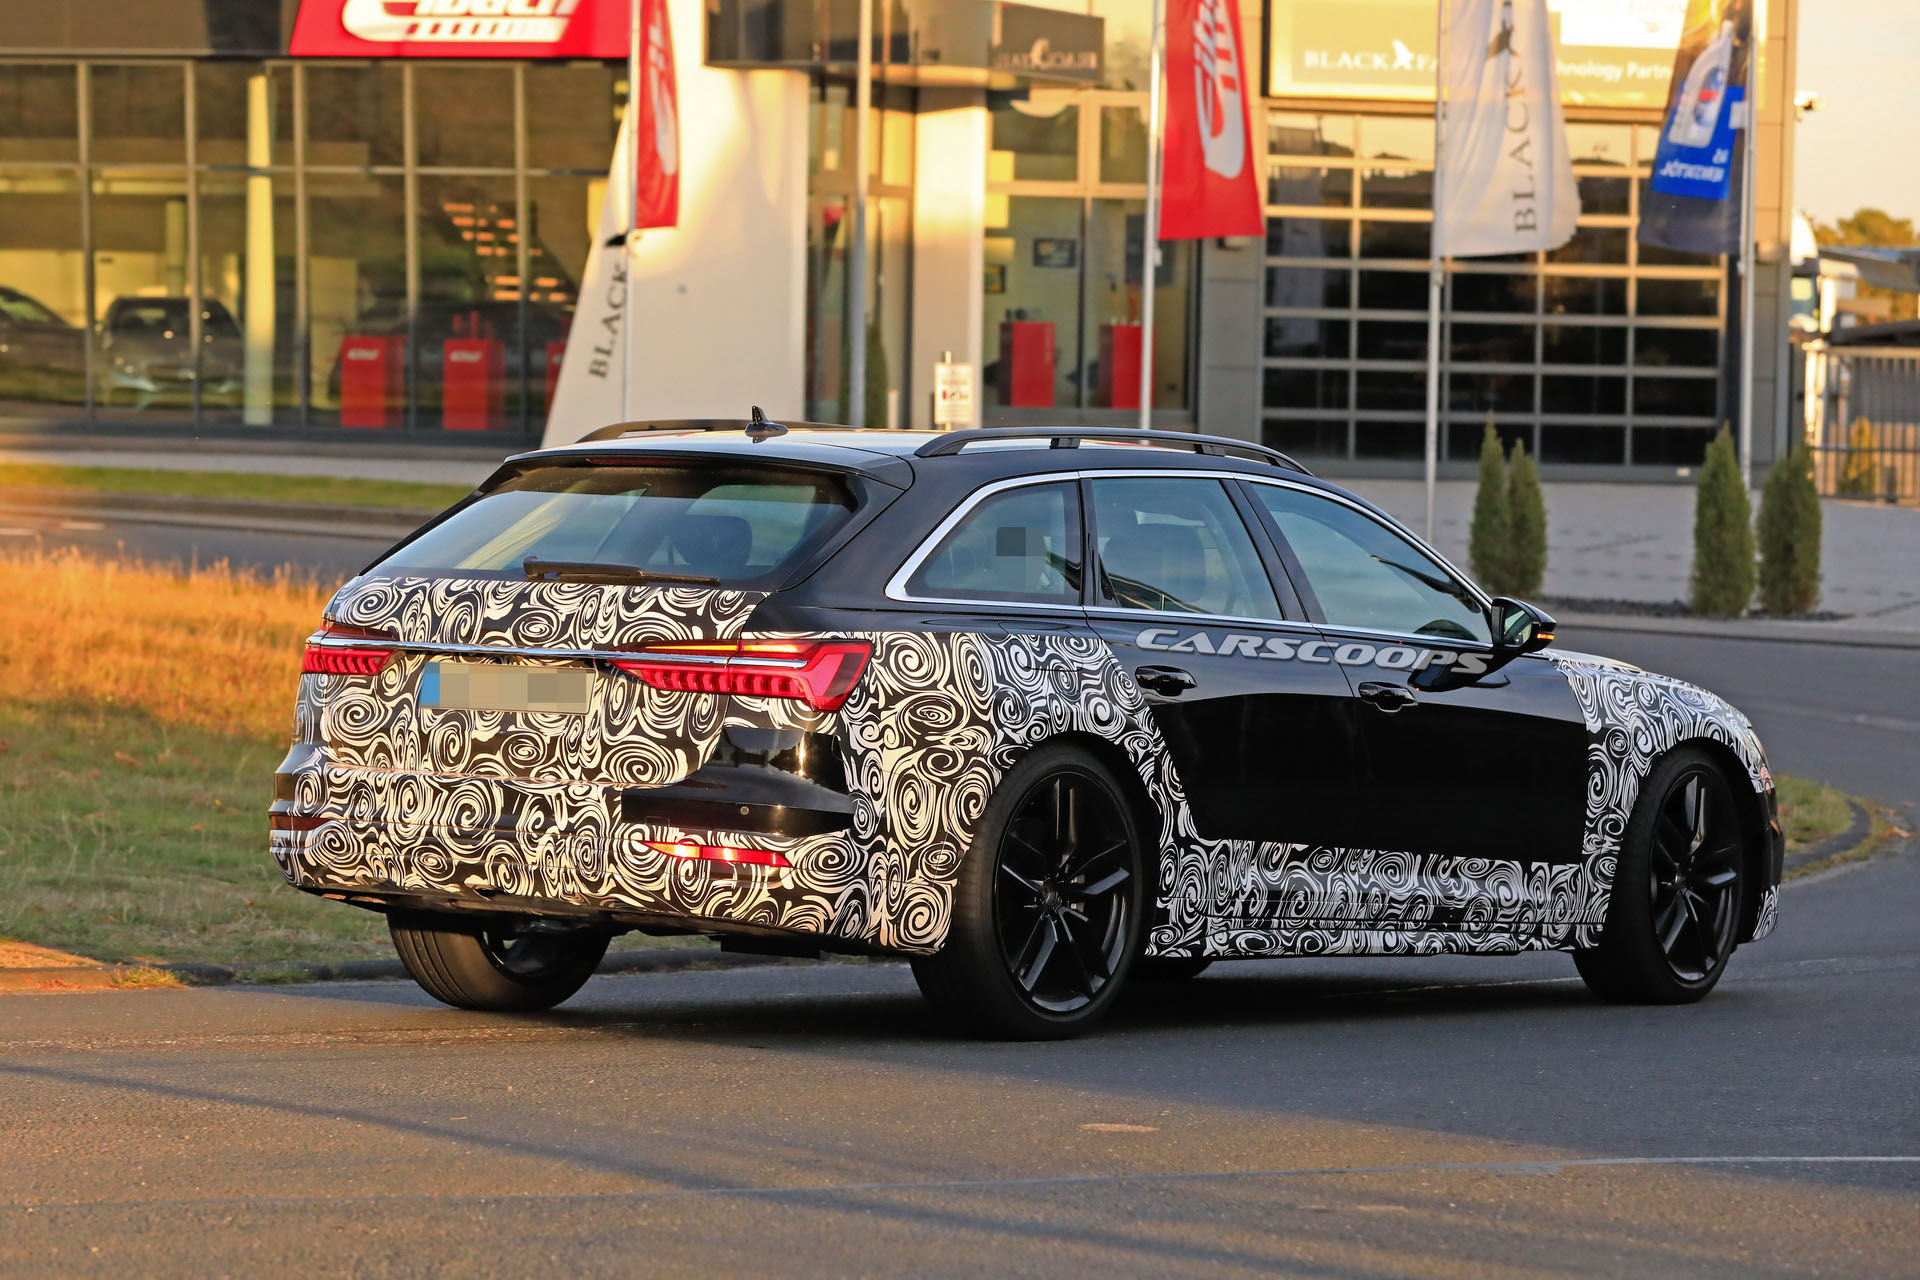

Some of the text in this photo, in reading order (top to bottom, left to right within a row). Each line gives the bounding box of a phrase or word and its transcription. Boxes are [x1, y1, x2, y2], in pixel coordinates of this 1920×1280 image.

[1303, 49, 1389, 71] BLACK
[1504, 68, 1538, 232] BLACK
[588, 261, 627, 378] BLACK
